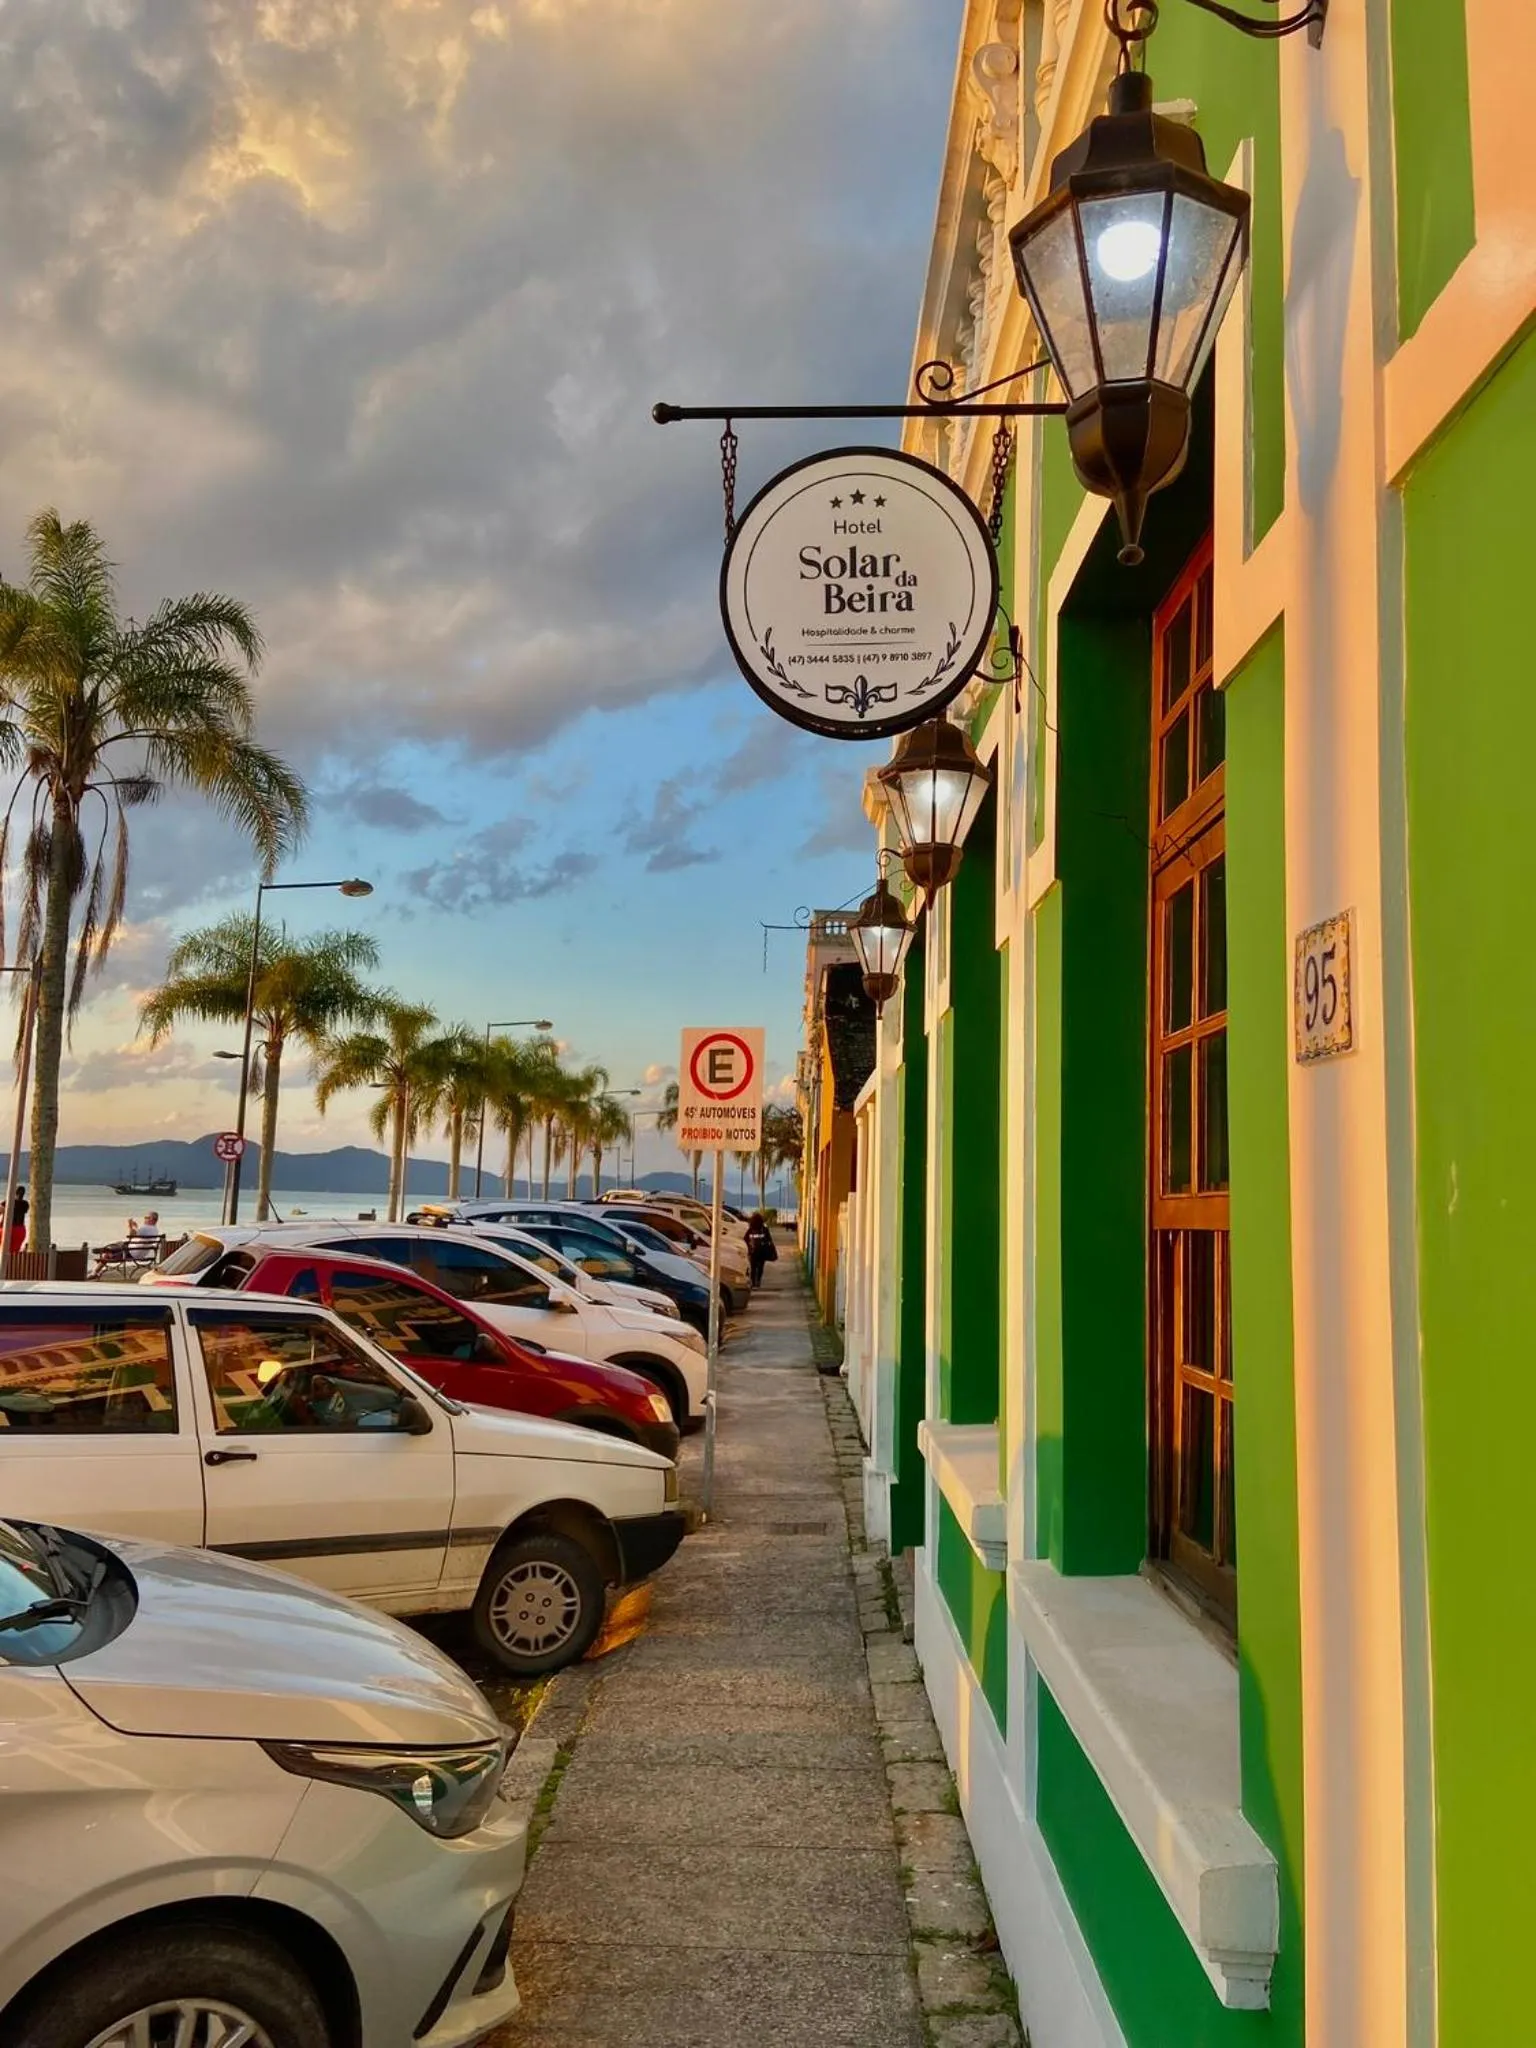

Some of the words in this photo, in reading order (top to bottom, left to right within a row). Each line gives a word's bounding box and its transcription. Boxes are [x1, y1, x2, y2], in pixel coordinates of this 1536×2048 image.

[833, 518, 882, 534] Hotel
[799, 545, 900, 580] Solar
[895, 570, 917, 587] da
[824, 583, 915, 614] Beira
[801, 626, 868, 637] Hospitalidade
[870, 626, 877, 634] &
[879, 626, 915, 634] charme
[788, 655, 805, 666] (47)
[806, 655, 830, 664] 3444
[862, 653, 880, 664] (47)
[1304, 943, 1337, 1032] 95
[708, 1048, 734, 1083] E
[700, 1105, 756, 1119] AUTOMÓVEIS
[681, 1128, 723, 1140] PROIBIDO
[725, 1128, 756, 1140] MOTOS
